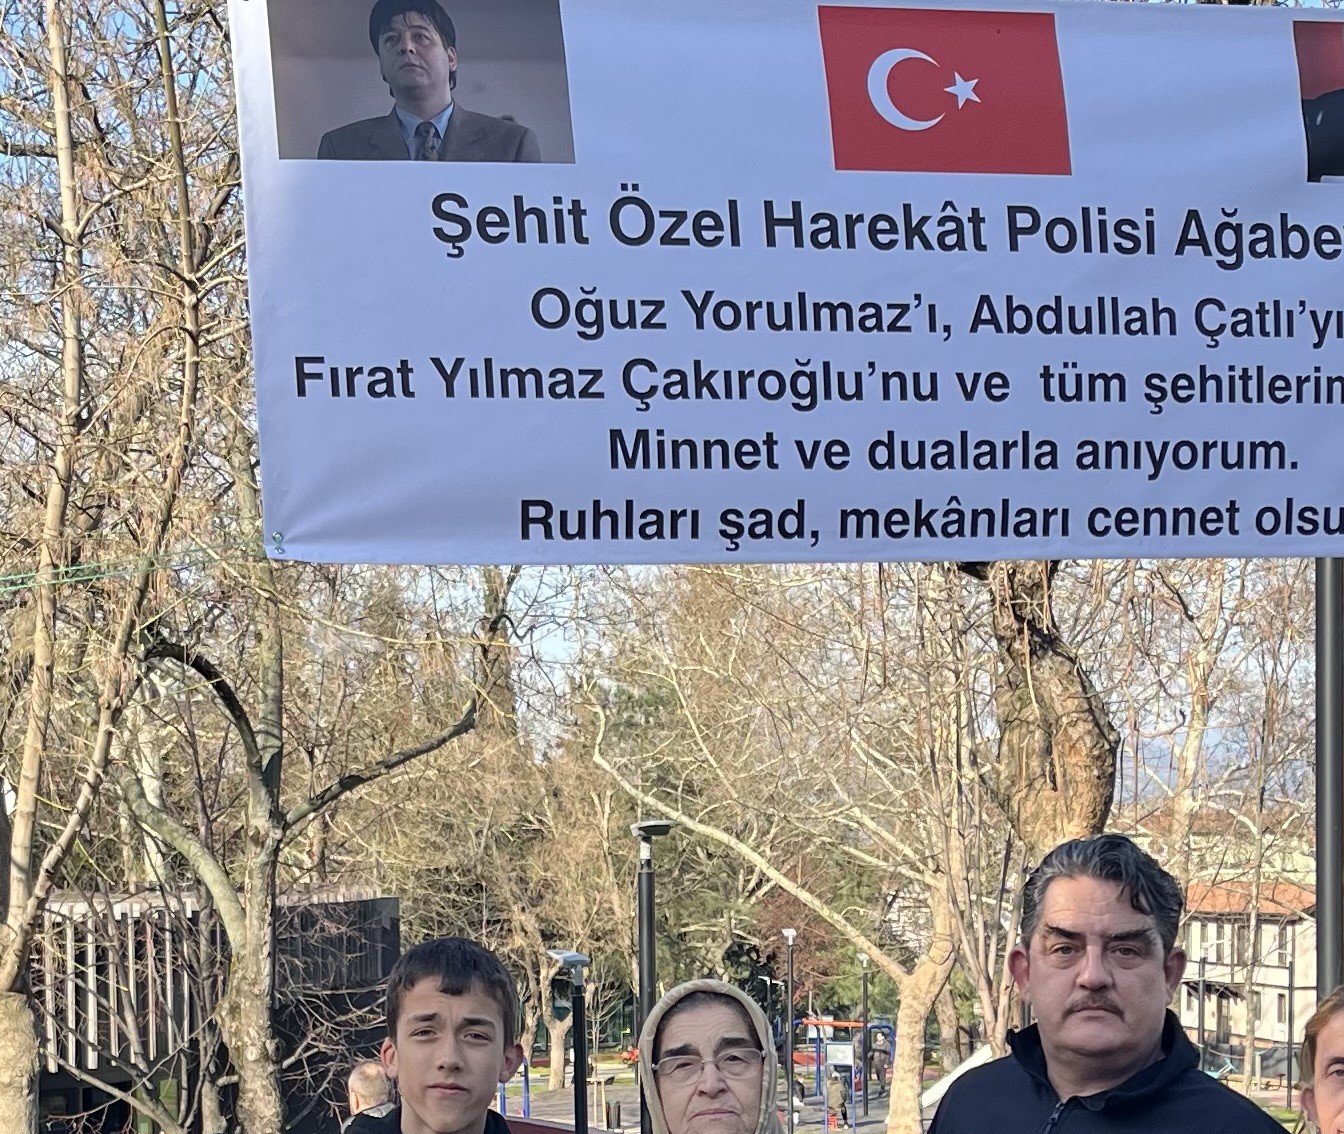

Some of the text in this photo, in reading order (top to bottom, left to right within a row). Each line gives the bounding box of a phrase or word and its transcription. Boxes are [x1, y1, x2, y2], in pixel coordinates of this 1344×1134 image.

[431, 192, 590, 259] Şehit
[609, 183, 741, 248] Özel
[763, 199, 988, 253] Harekât
[1006, 204, 1156, 256] Polisi
[531, 286, 668, 341] Oğuz
[969, 294, 1177, 337] Abdullah
[294, 356, 416, 399] Fırat
[429, 356, 605, 400] Yılmaz
[954, 371, 1011, 403] ve
[1039, 361, 1127, 403] tüm
[609, 428, 1299, 481] Minnet ve dualarla anıyorum.
[520, 498, 700, 541] Ruhları
[718, 498, 820, 552] şad,
[839, 495, 1070, 540] mekânları
[1087, 499, 1241, 538] cennet
